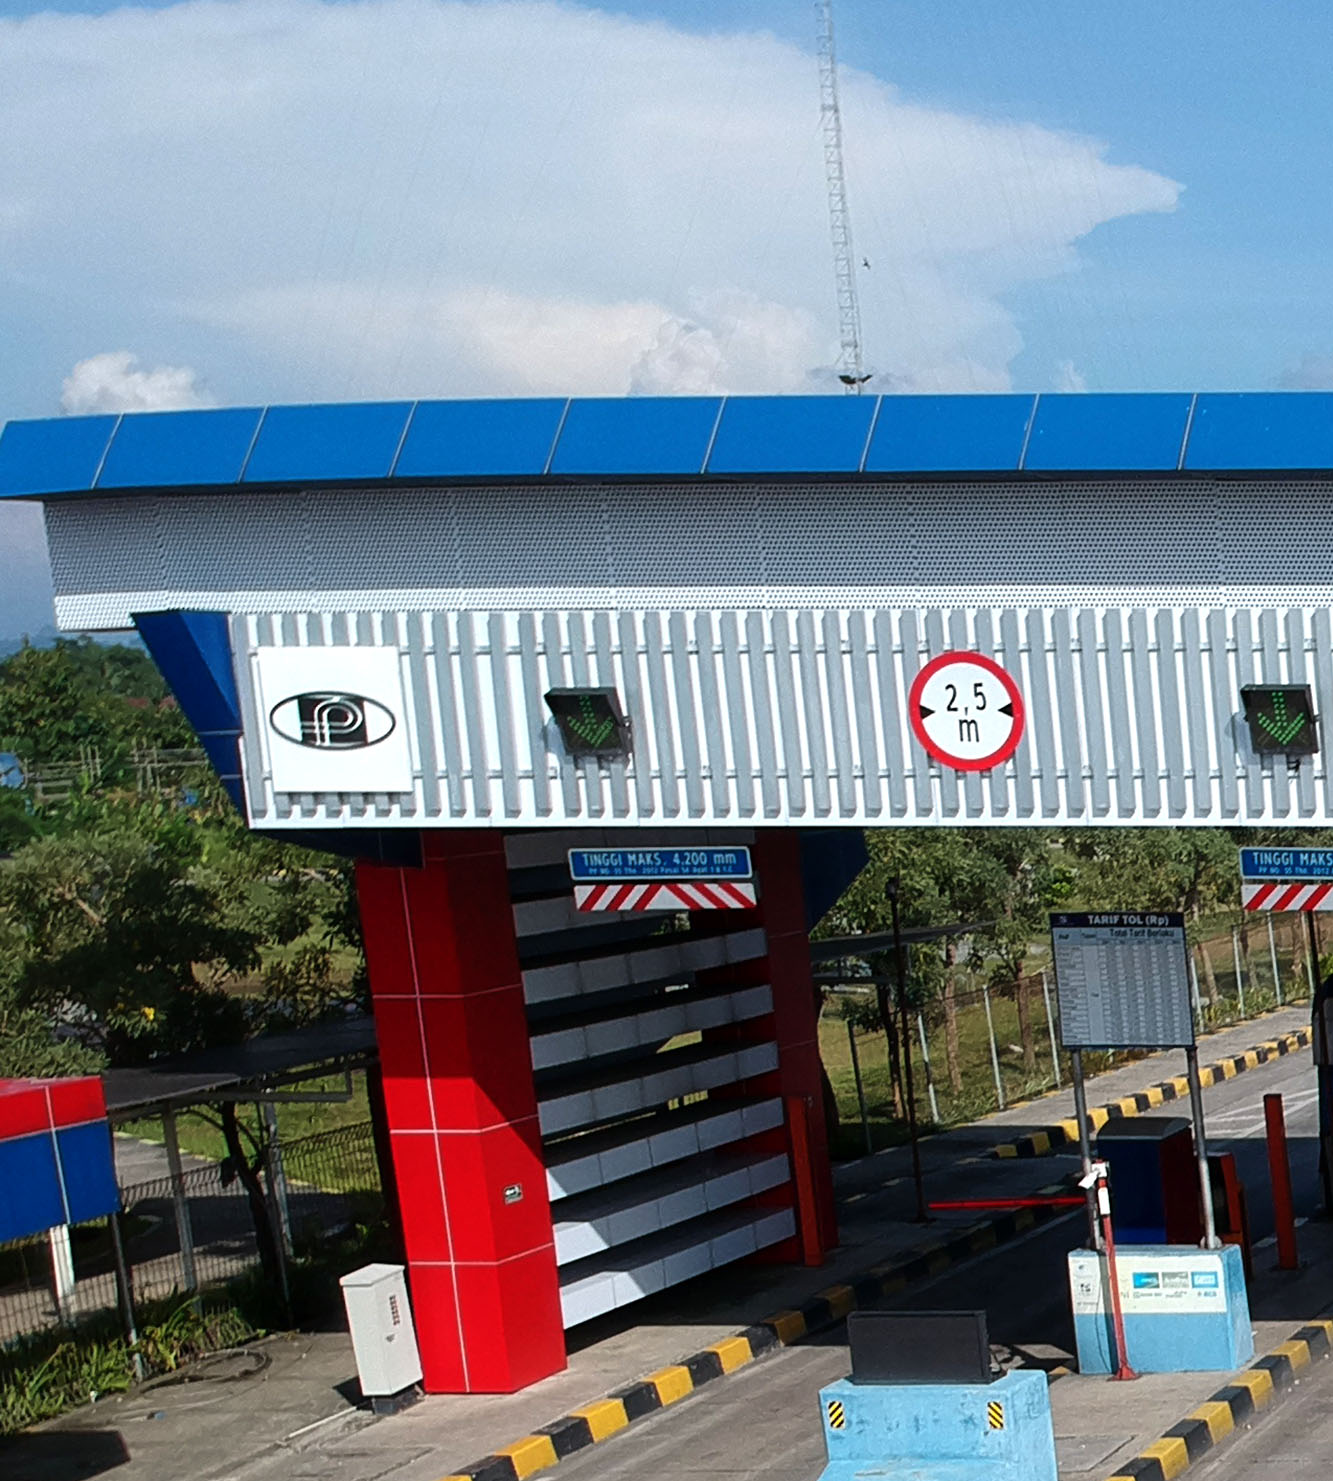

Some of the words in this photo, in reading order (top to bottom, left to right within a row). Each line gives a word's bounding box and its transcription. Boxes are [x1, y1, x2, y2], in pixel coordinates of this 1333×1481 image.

[944, 682, 987, 716] 2,5
[958, 718, 980, 743] m
[582, 853, 622, 867] TINGGI
[627, 852, 668, 867] MAKS.
[672, 852, 708, 866] 4.200
[713, 853, 737, 865] mm
[1252, 852, 1294, 866] TINGGI
[1087, 915, 1120, 925] TARIF
[1122, 915, 1144, 925] TOL
[1145, 915, 1169, 926] (Rp)
